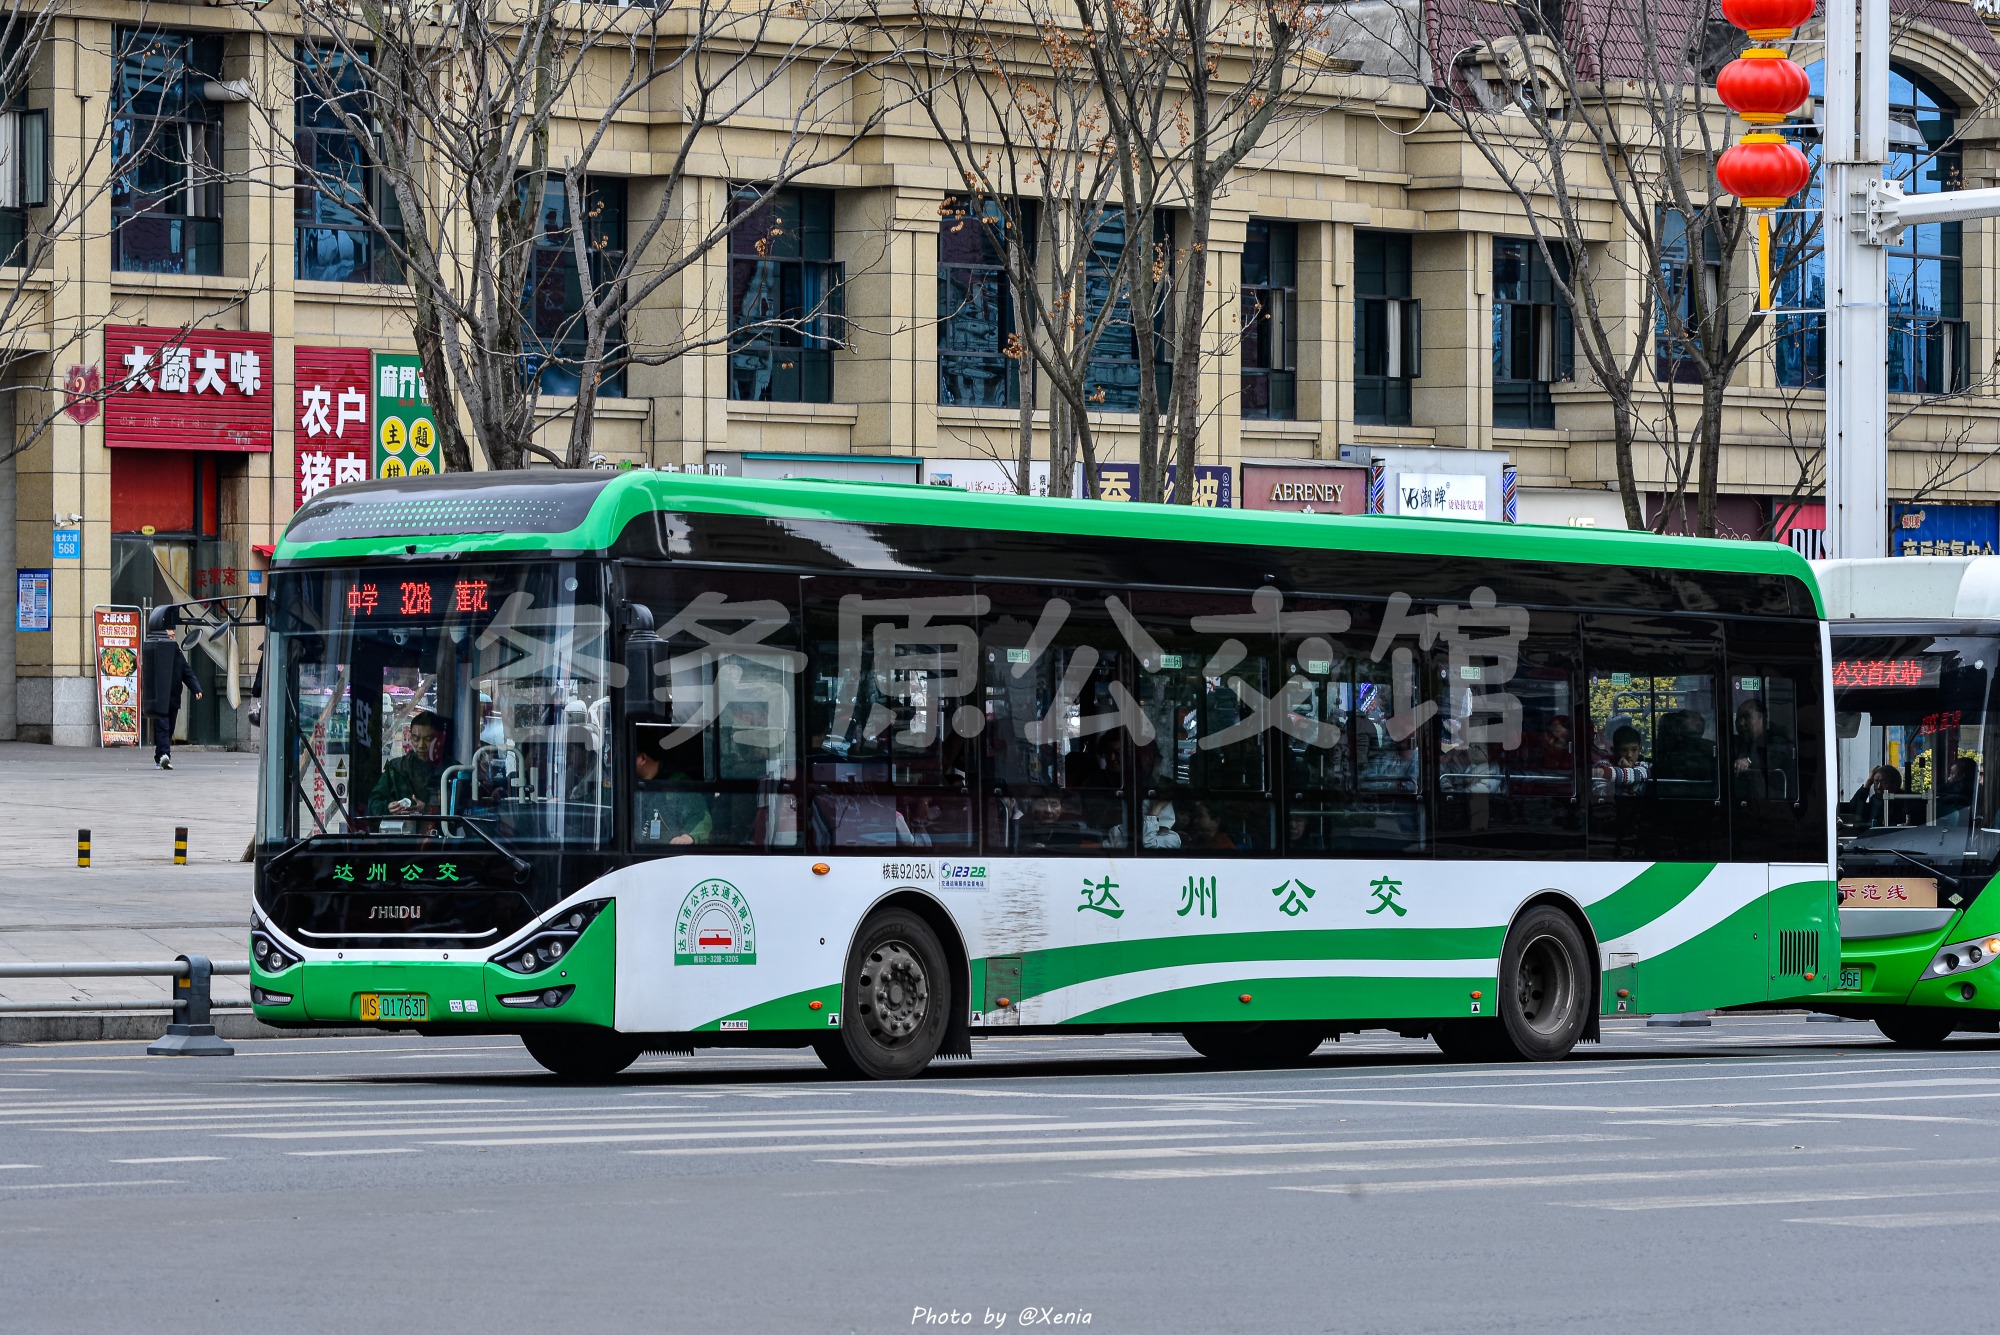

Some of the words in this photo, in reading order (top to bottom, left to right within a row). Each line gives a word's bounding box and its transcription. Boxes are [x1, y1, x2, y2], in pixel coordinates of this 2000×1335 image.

[122, 345, 262, 396] 大厨大味
[301, 385, 367, 438] 农户
[301, 451, 367, 503] 猪肉
[1270, 482, 1345, 503] AERENEY
[58, 543, 75, 554] 568
[348, 583, 378, 616] 中学
[400, 582, 432, 614] 32路
[454, 580, 488, 613] 莲花
[333, 862, 460, 881] 达州公交
[882, 863, 935, 880] 核载92/35人
[1077, 875, 1408, 919] 达州公交
[1838, 884, 1908, 901] 示范线
[368, 905, 421, 919] SHUDU
